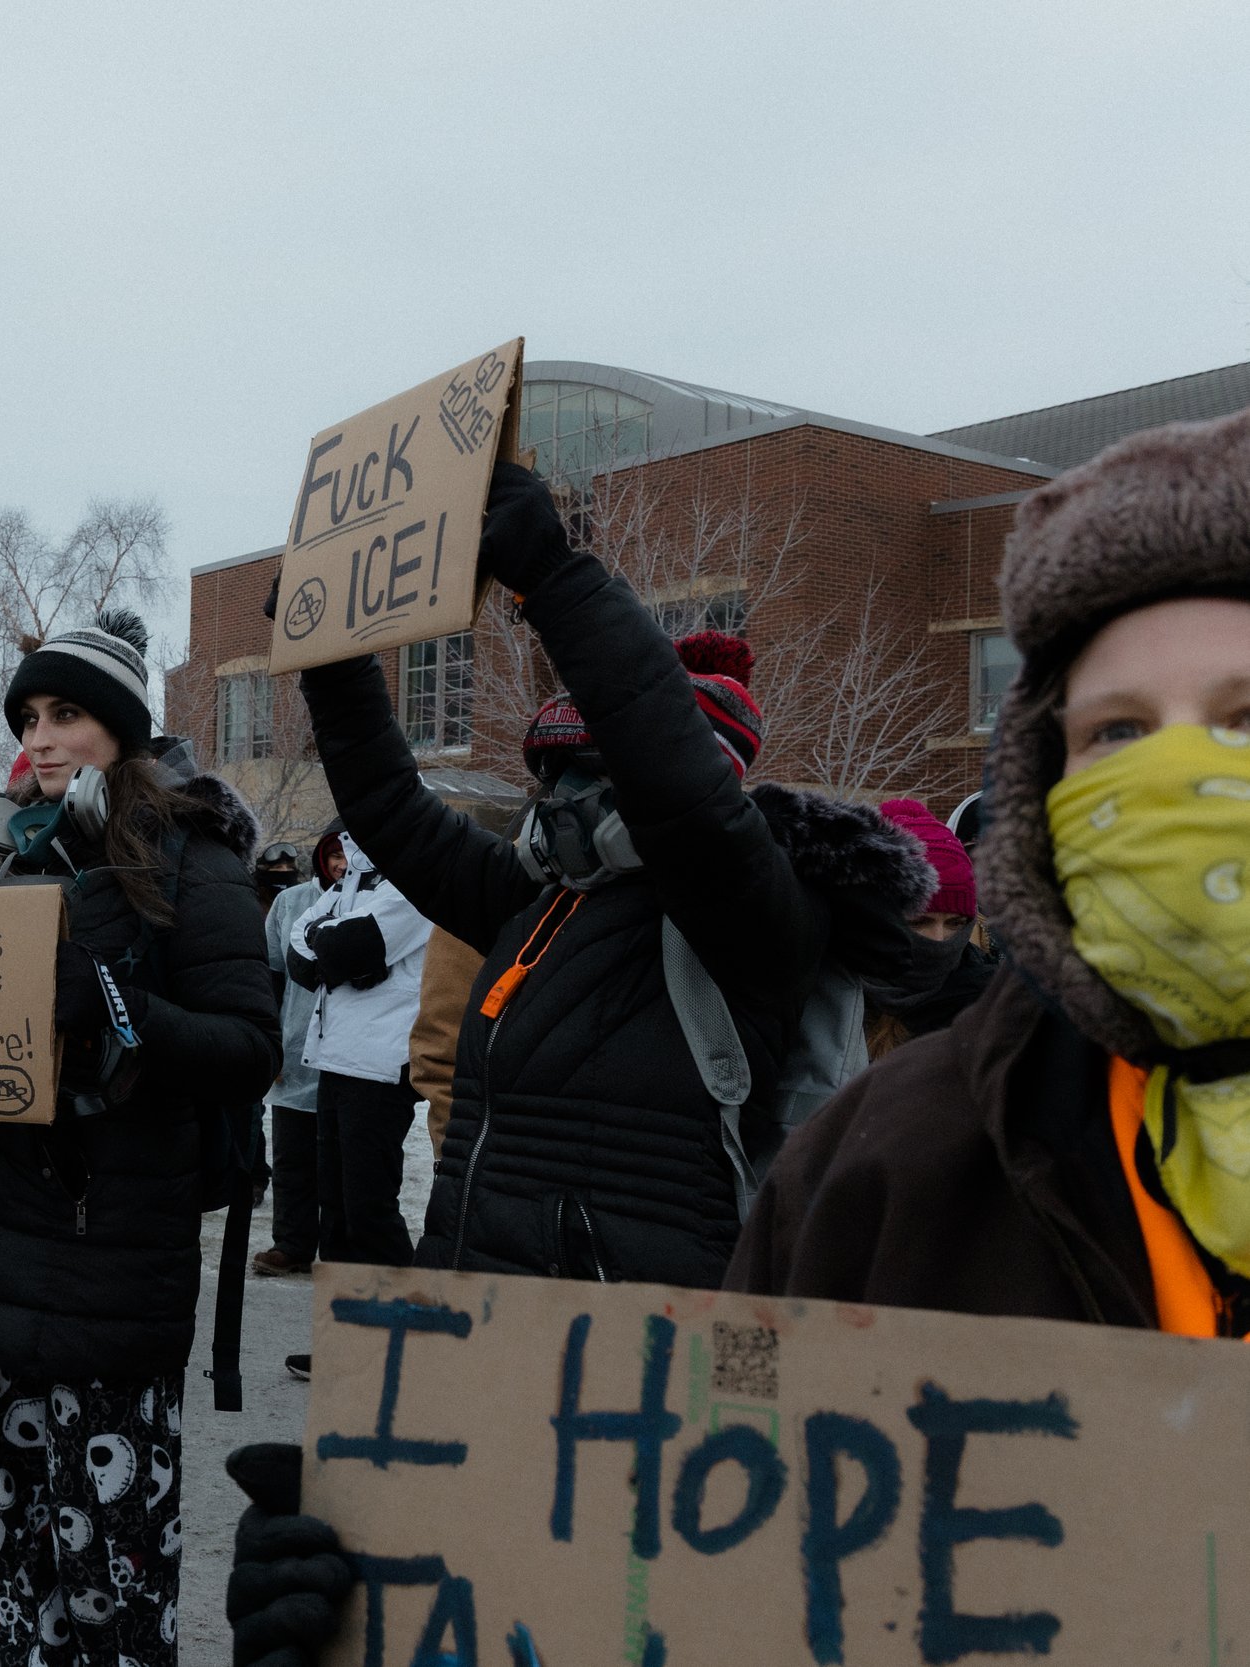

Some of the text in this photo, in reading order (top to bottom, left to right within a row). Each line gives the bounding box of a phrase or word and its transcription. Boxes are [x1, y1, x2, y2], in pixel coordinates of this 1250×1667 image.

[345, 512, 447, 630] ICE!
[100, 965, 130, 1026] HART
[316, 1297, 1080, 1665] I HOPE
